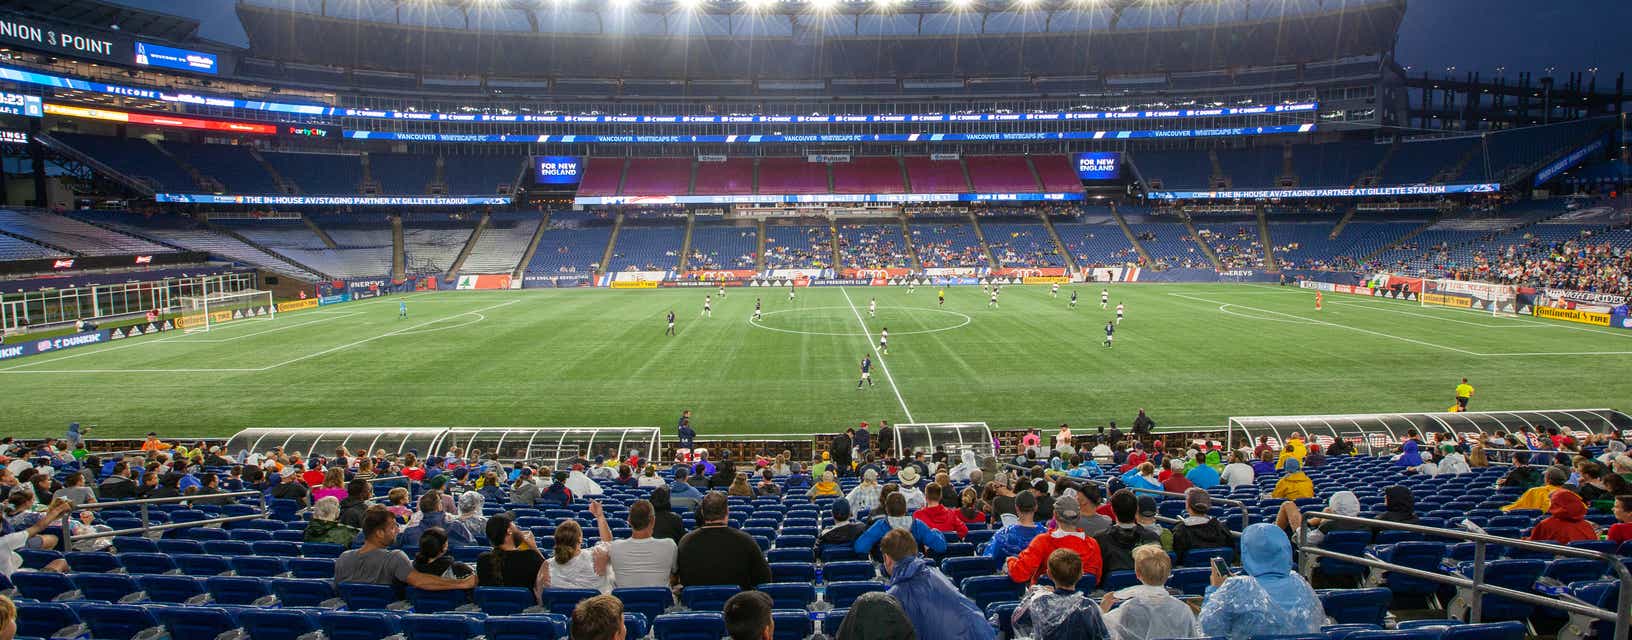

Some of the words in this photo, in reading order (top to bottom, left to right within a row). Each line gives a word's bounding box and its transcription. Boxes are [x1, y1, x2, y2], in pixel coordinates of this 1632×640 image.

[61, 33, 113, 55] POINT
[106, 86, 154, 98] WELCOME
[397, 133, 437, 141] VANCOUVER
[1317, 188, 1354, 197] PARTNER
[1355, 188, 1366, 196] AT
[1367, 187, 1406, 195] GILLETTE
[1407, 185, 1446, 194] STADIUM
[246, 196, 263, 204] THE
[264, 196, 304, 204] IN-HOUSE
[354, 197, 391, 205] PARTNER
[402, 197, 436, 205] GILLETTE
[437, 197, 469, 205] STADIUM
[1594, 293, 1632, 304] RIDERS
[1536, 306, 1581, 320] Continental
[1590, 314, 1609, 324] TIRE
[62, 333, 101, 348] DUNKIN'
[0, 345, 23, 359] KIN'
